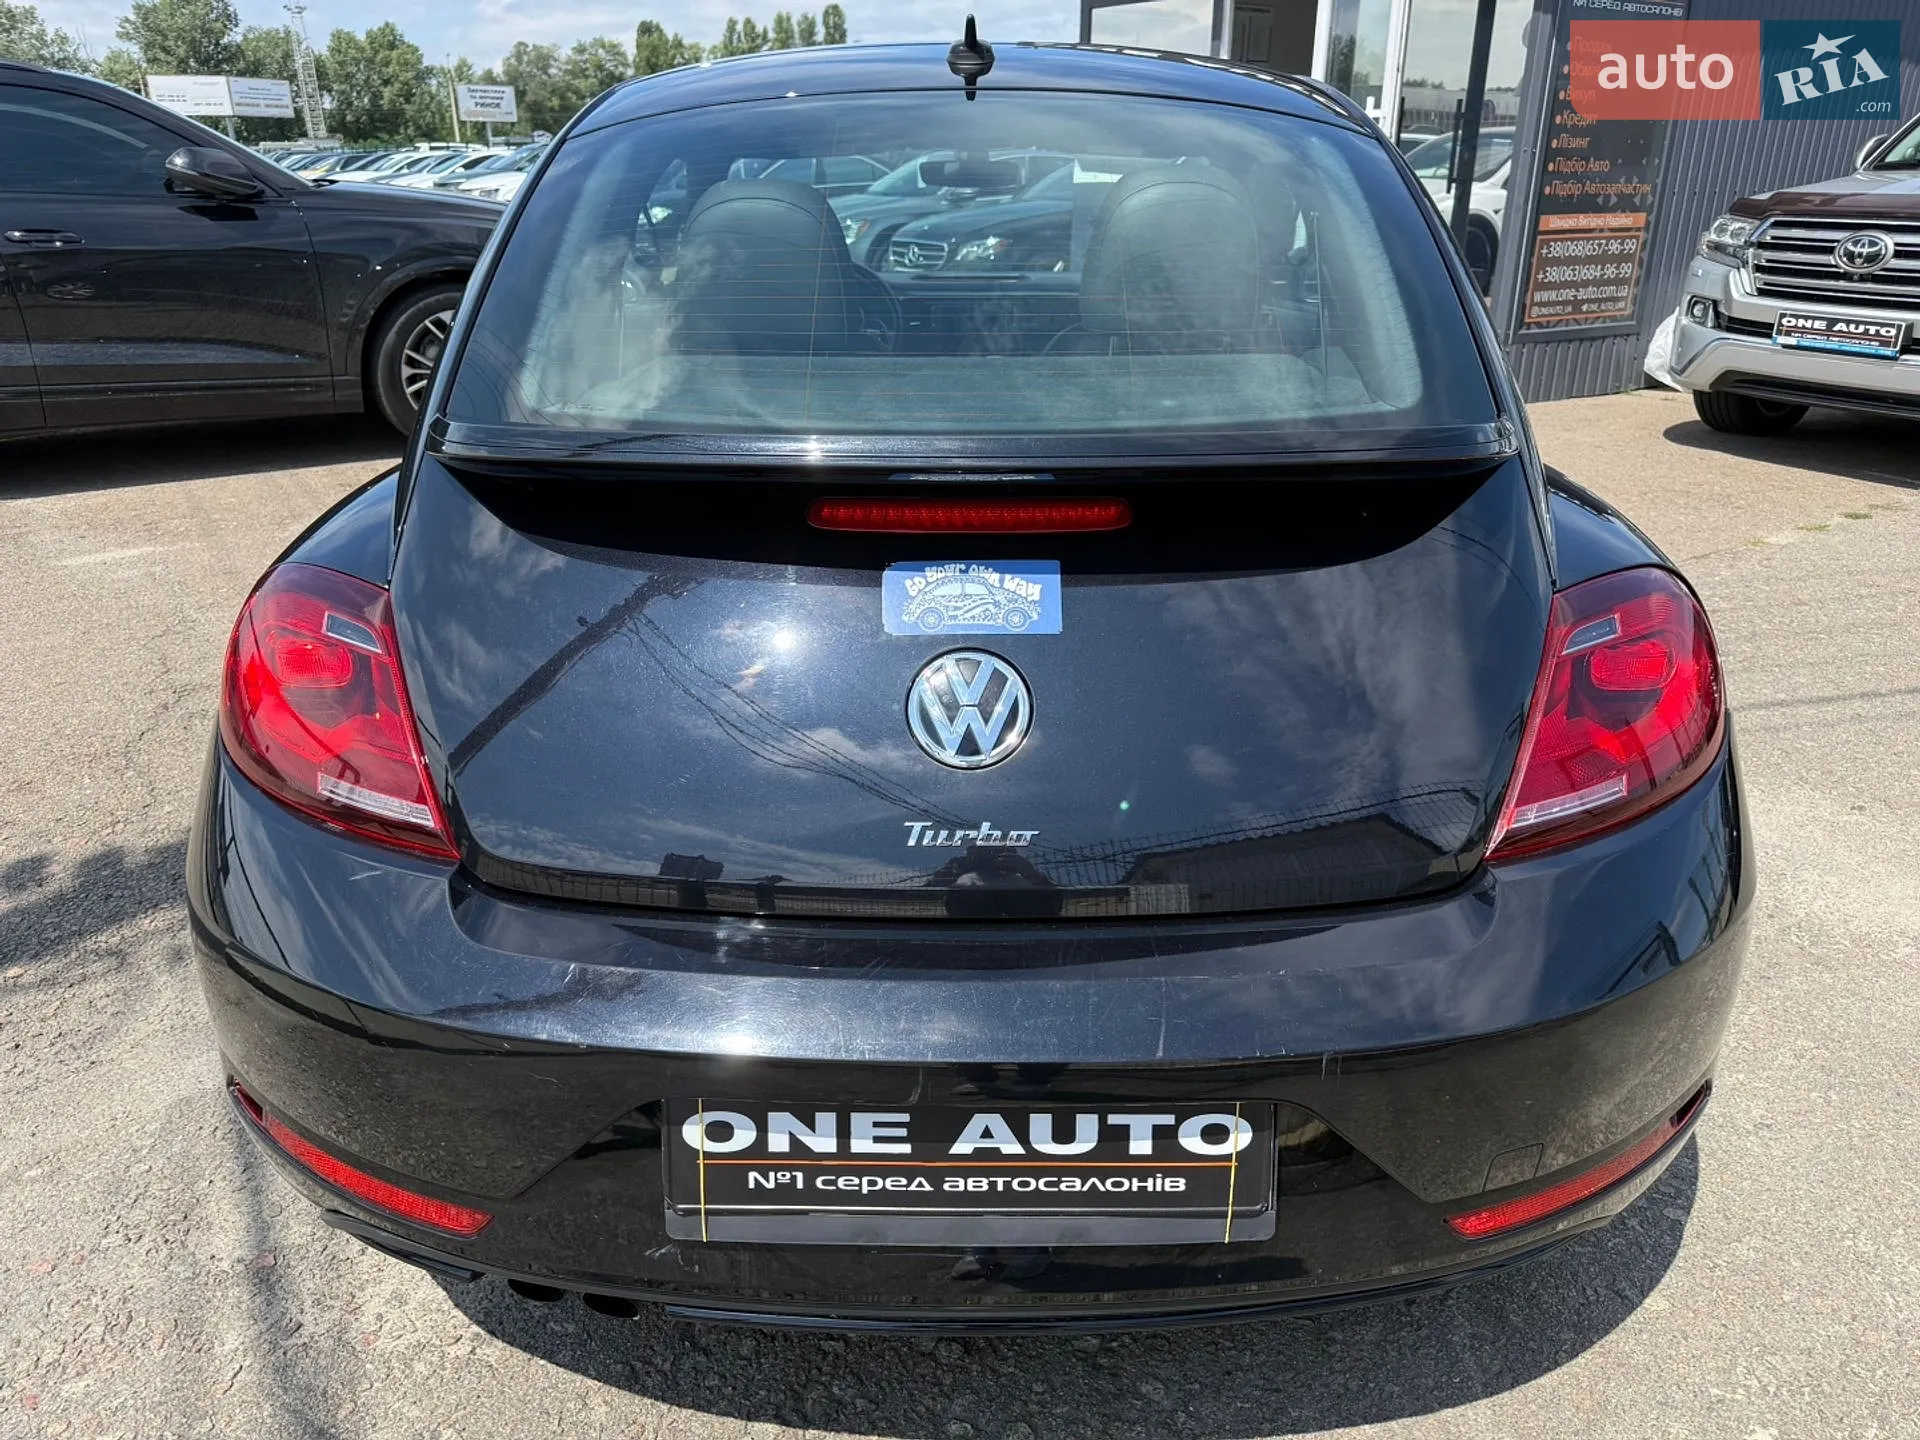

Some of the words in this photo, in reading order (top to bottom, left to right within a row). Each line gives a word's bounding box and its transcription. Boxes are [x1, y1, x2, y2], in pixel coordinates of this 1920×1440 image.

[1561, 109, 1597, 128] Кредит
[1558, 133, 1591, 149] Лізинг
[1554, 157, 1586, 175] Підбір
[1587, 159, 1611, 172] Авто
[1550, 179, 1583, 197] Підбір
[1540, 238, 1637, 258] +38(068)657-96-99
[1536, 262, 1632, 283] +38(063)684-96-99
[1533, 285, 1629, 303] www.one-auto.com.ua
[1781, 317, 1828, 330] ONE
[1832, 322, 1897, 337] AUTO
[903, 821, 1041, 847] Turbo
[682, 1110, 912, 1154] ONE
[948, 1113, 1253, 1155] AUTO
[747, 1170, 804, 1190] №1
[815, 1175, 934, 1195] серед
[942, 1172, 1187, 1192] автосалонів
